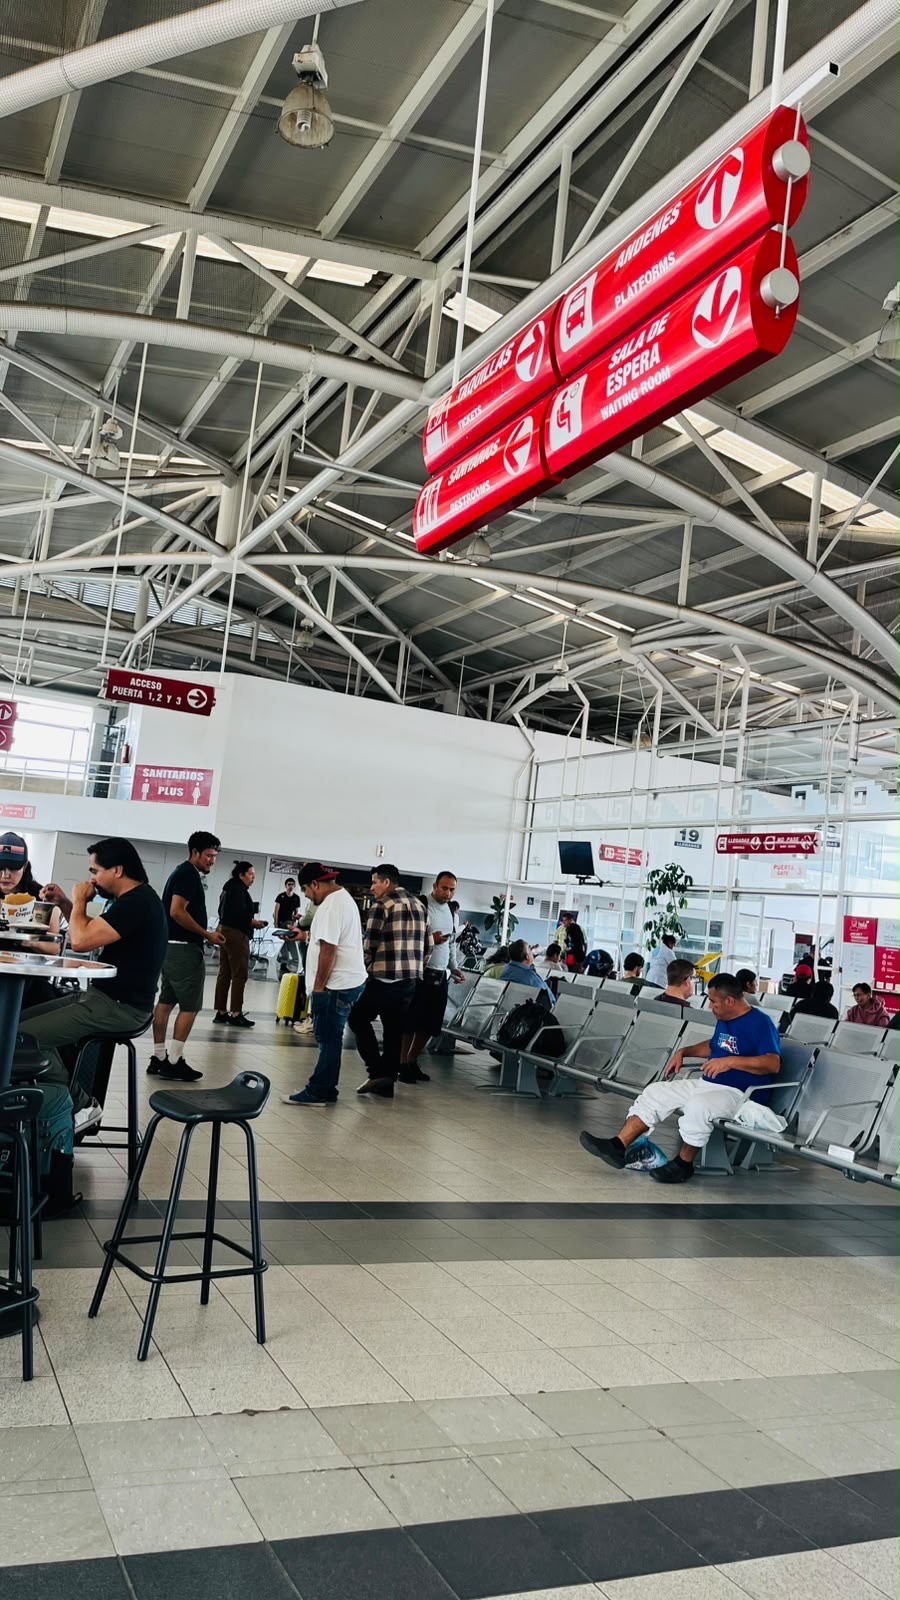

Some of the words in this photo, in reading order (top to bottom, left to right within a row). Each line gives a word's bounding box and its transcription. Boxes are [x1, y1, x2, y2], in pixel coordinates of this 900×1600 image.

[614, 201, 682, 272] ANDENES
[614, 251, 677, 309] PLATFORMS
[608, 328, 647, 370] SALA
[647, 312, 671, 343] DE
[456, 342, 515, 401] TAQUILLAS
[606, 342, 661, 397] ESPERA
[600, 386, 639, 421] WAITING
[640, 365, 672, 396] ROOM
[457, 405, 483, 431] TICKETS
[449, 480, 492, 513] RESTROOMS
[112, 686, 143, 699] PUERTA
[167, 695, 173, 704] Y
[175, 697, 182, 705] 3
[130, 677, 162, 690] ACCESO
[142, 768, 205, 781] SANITARIOS
[157, 786, 184, 797] PLUS
[679, 829, 700, 842] 19
